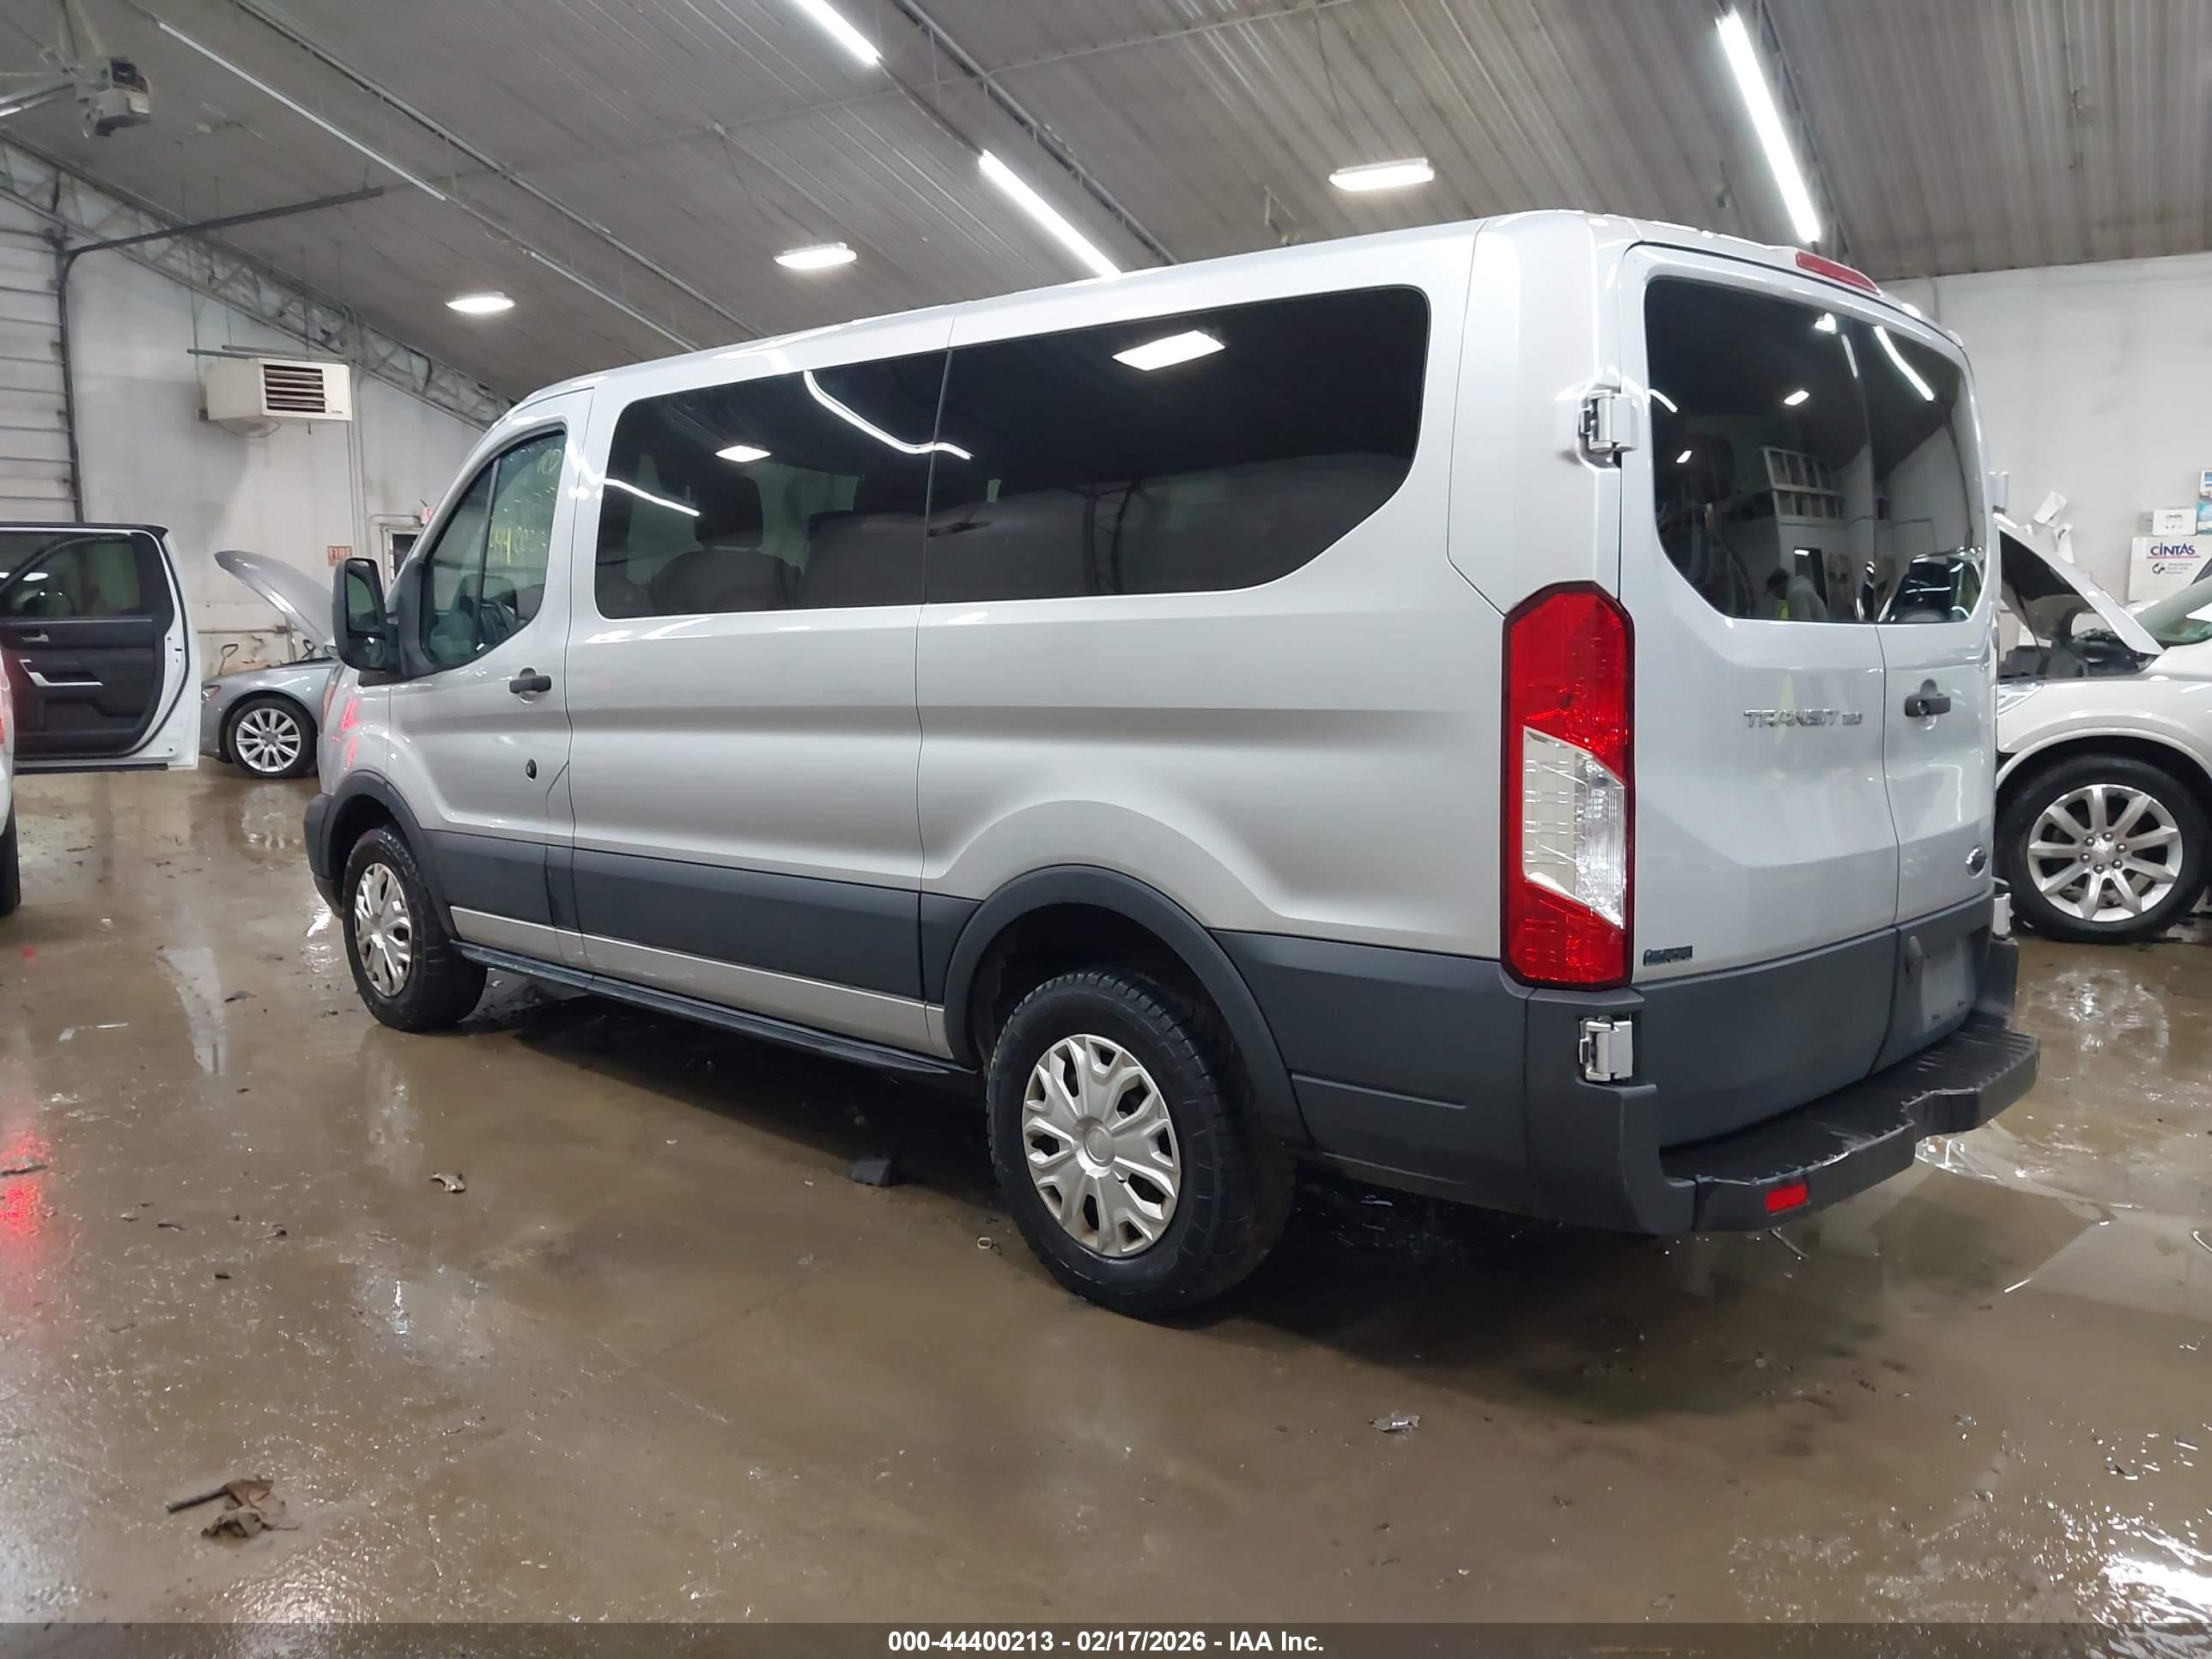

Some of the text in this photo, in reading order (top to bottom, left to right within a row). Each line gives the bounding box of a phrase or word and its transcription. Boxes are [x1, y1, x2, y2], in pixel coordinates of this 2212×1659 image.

[329, 547, 351, 558] FIRE
[2149, 542, 2196, 556] CINTAS
[1743, 708, 1839, 729] TRANSIT
